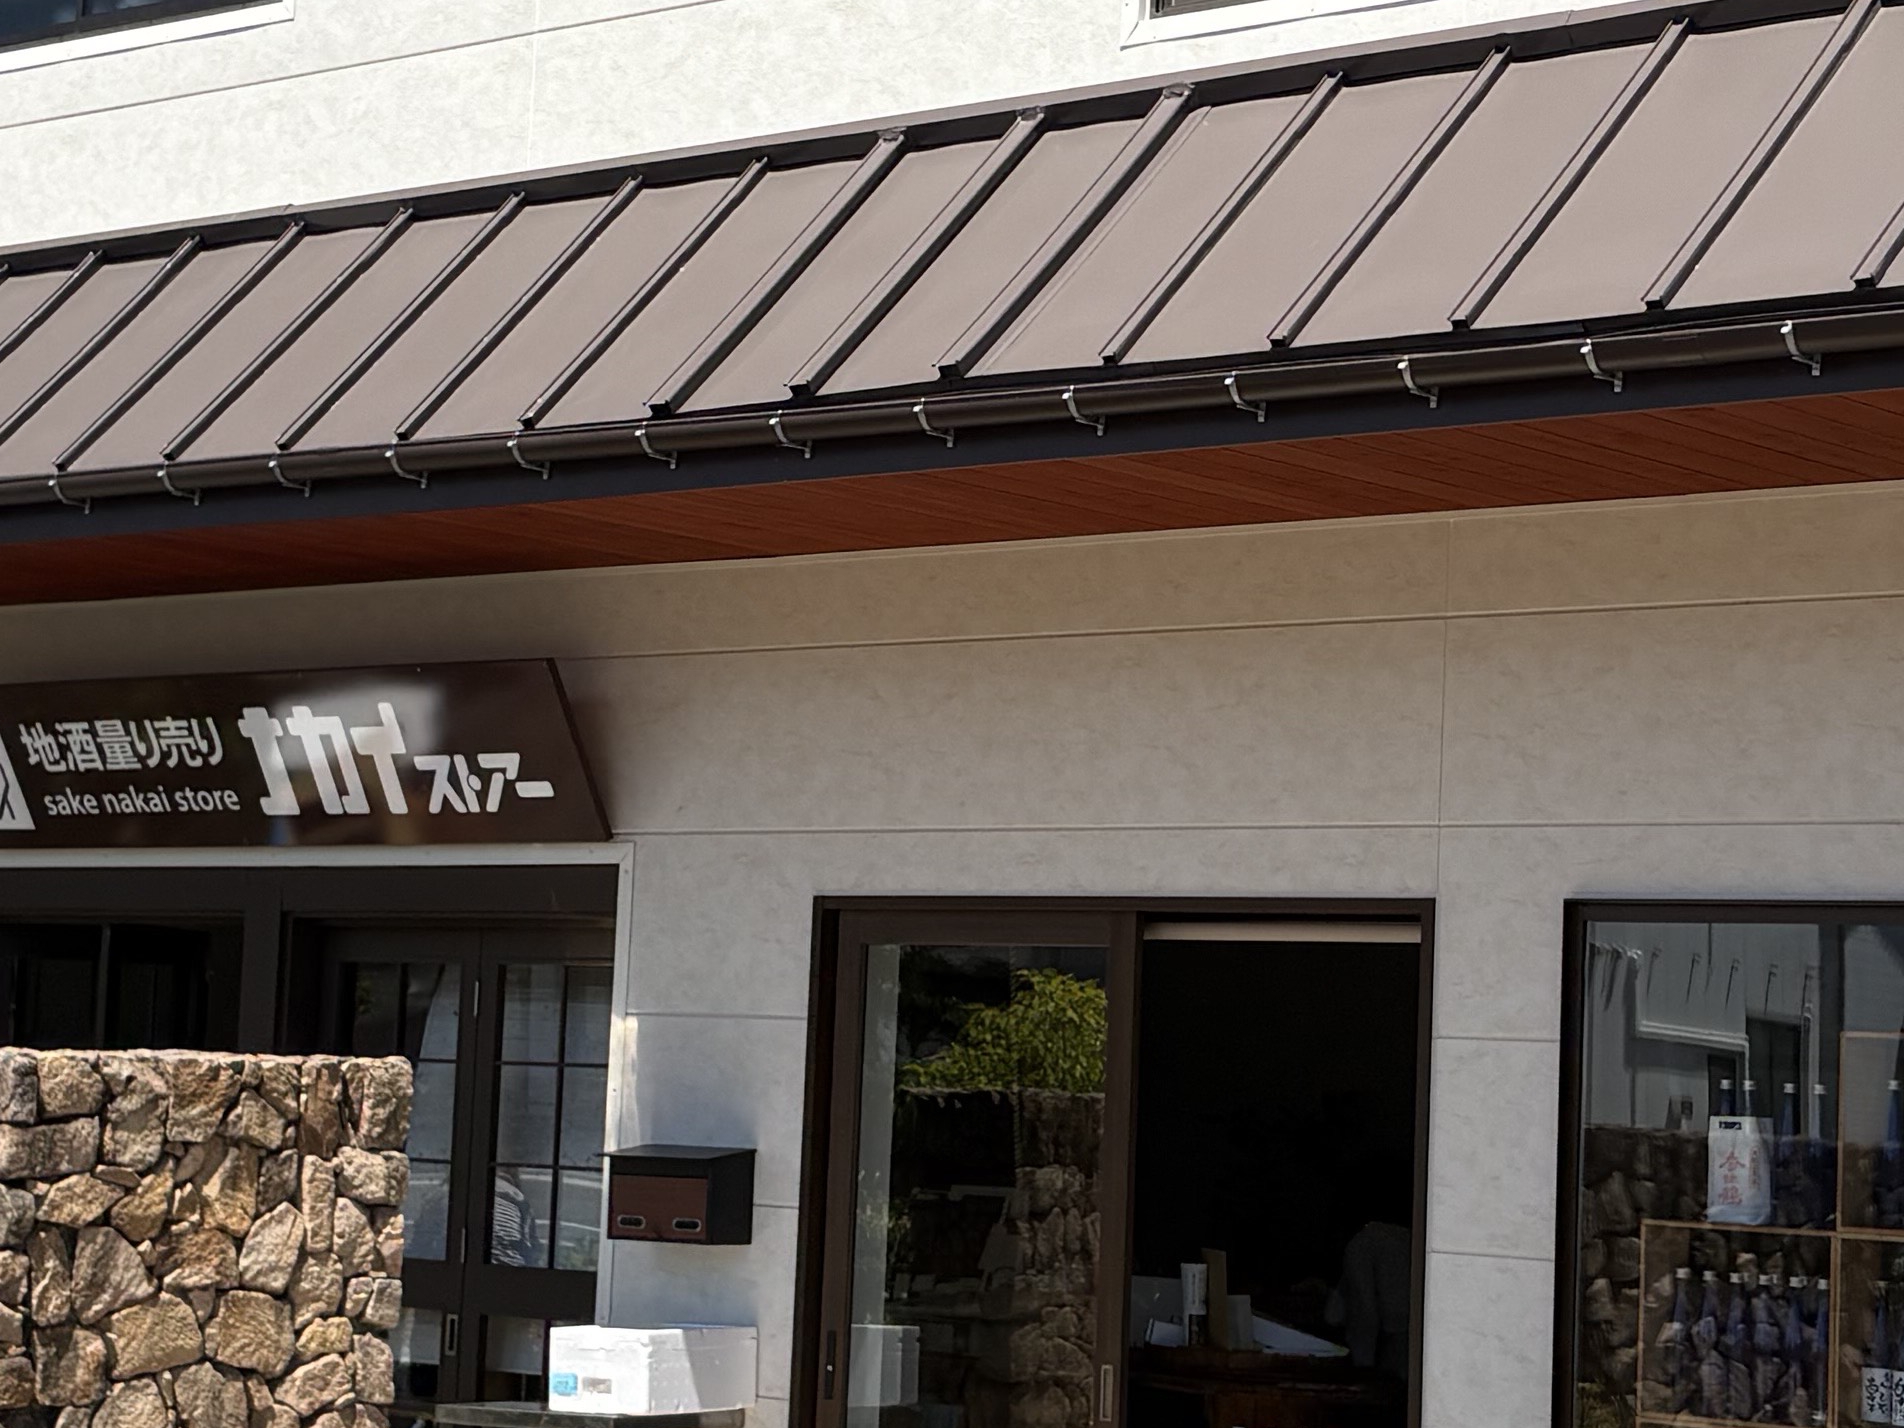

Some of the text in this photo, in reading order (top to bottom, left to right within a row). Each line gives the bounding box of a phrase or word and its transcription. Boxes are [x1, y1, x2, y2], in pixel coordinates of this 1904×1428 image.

[18, 716, 224, 772] 地酒量り売り
[44, 785, 241, 815] sake nakai store
